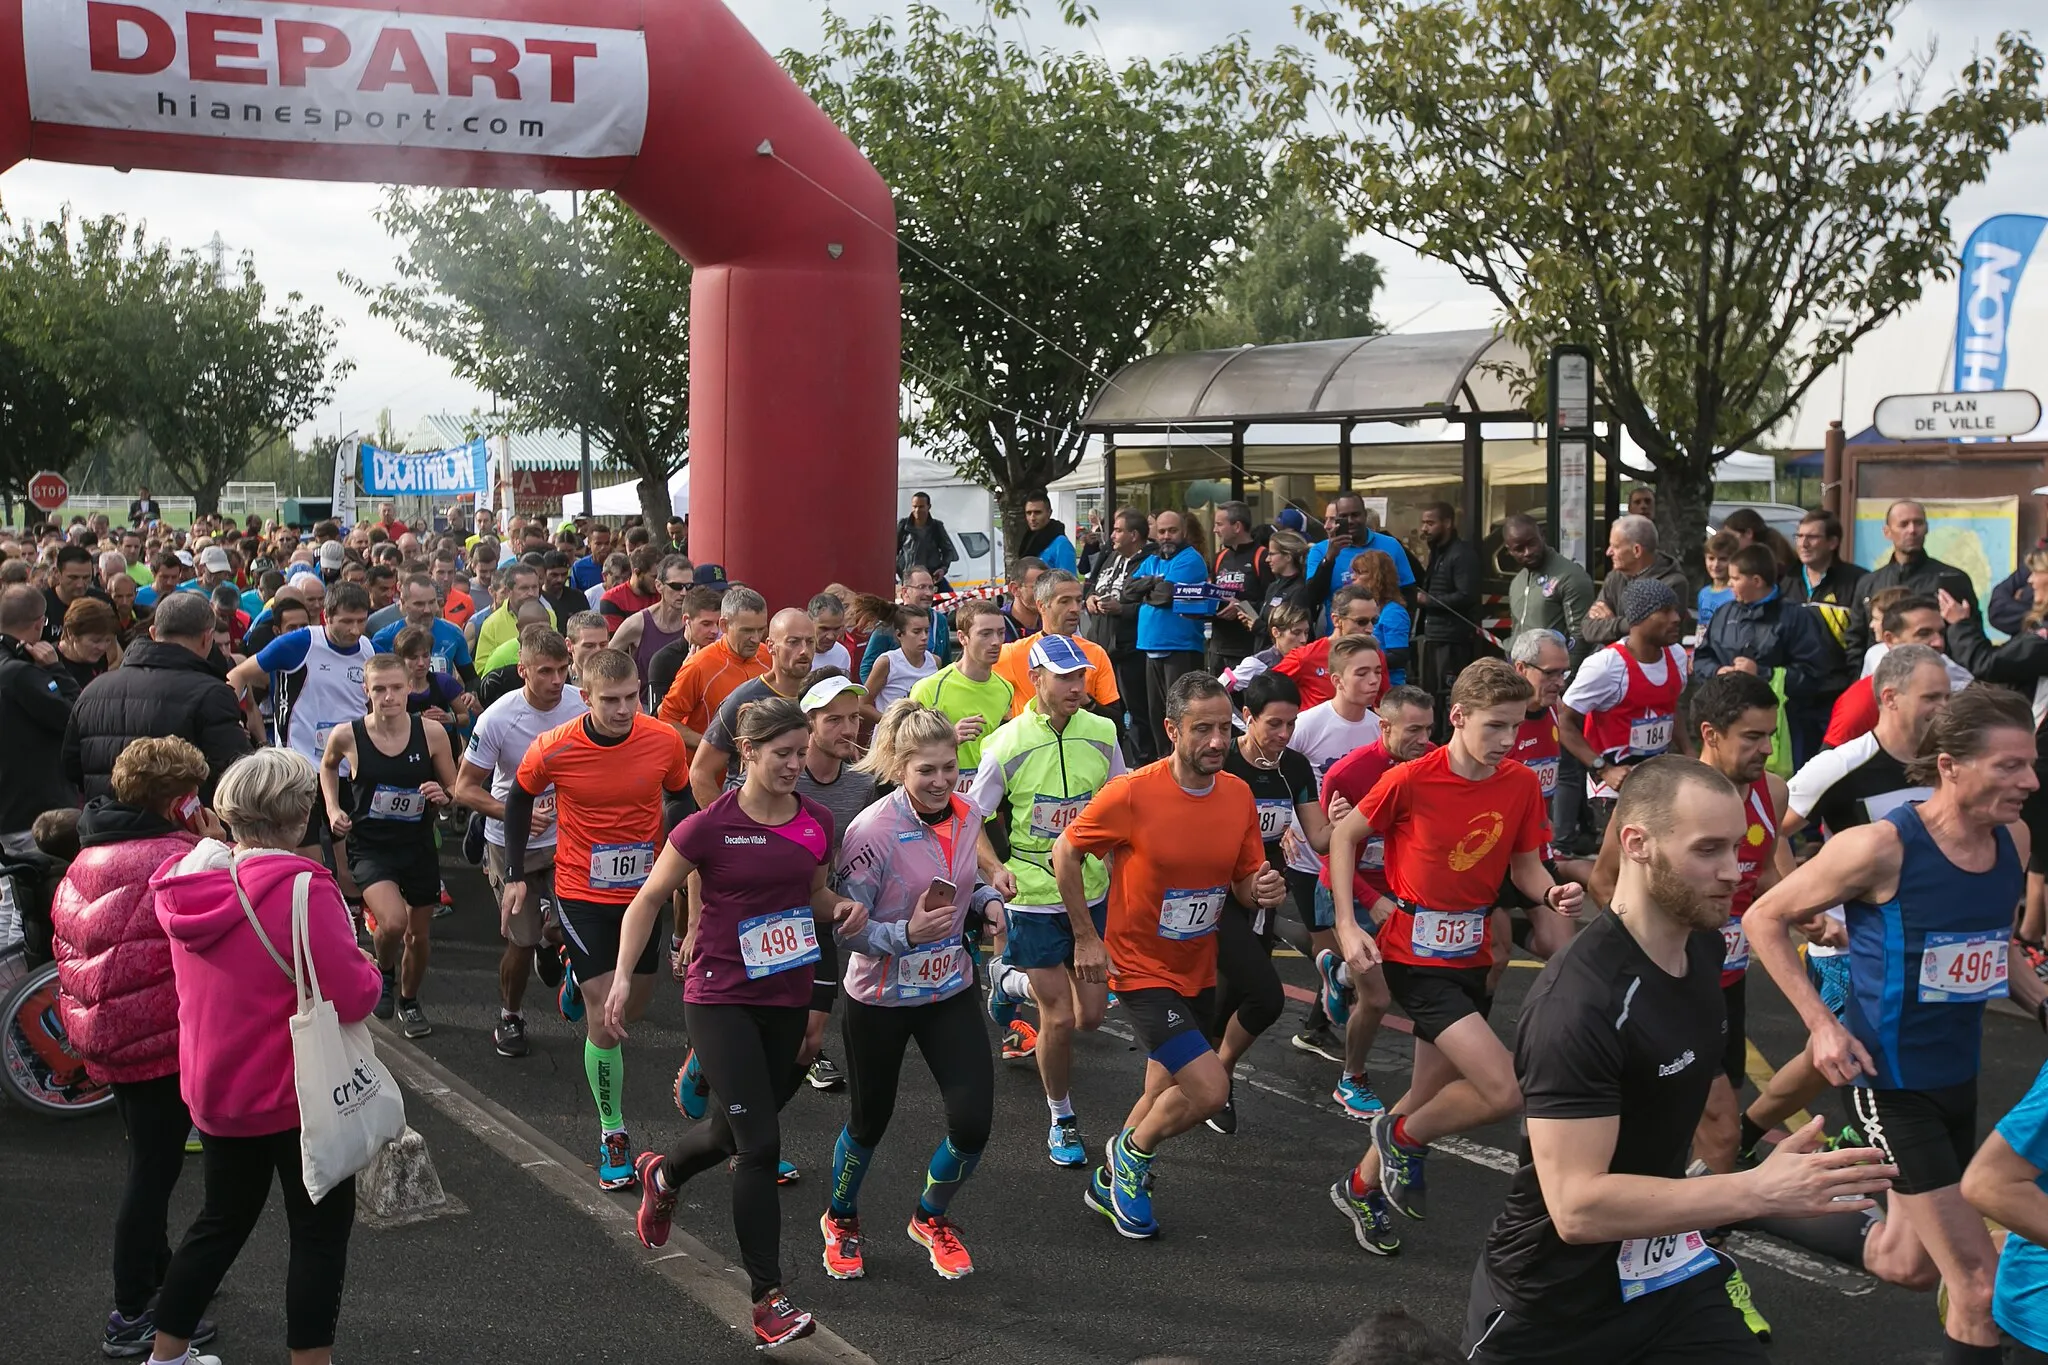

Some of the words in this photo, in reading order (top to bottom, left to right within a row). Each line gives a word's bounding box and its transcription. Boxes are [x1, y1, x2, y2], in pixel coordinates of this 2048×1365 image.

[87, 1, 598, 103] DEPART
[158, 92, 545, 138] hianesport.com
[1932, 401, 1978, 413] PLAN
[1915, 417, 1936, 431] DE
[1950, 416, 1996, 430] VILLE
[372, 444, 476, 492] DECATHLON
[33, 485, 66, 498] STOP
[1646, 726, 1664, 745] 184
[391, 797, 411, 812] 99
[724, 835, 750, 845] Decathlon
[612, 856, 636, 876] 161
[840, 844, 876, 881] enji
[1188, 902, 1208, 926] 72
[761, 926, 798, 957] 498
[1435, 919, 1466, 944] 513
[918, 954, 951, 981] 499
[1948, 950, 1993, 984] 496
